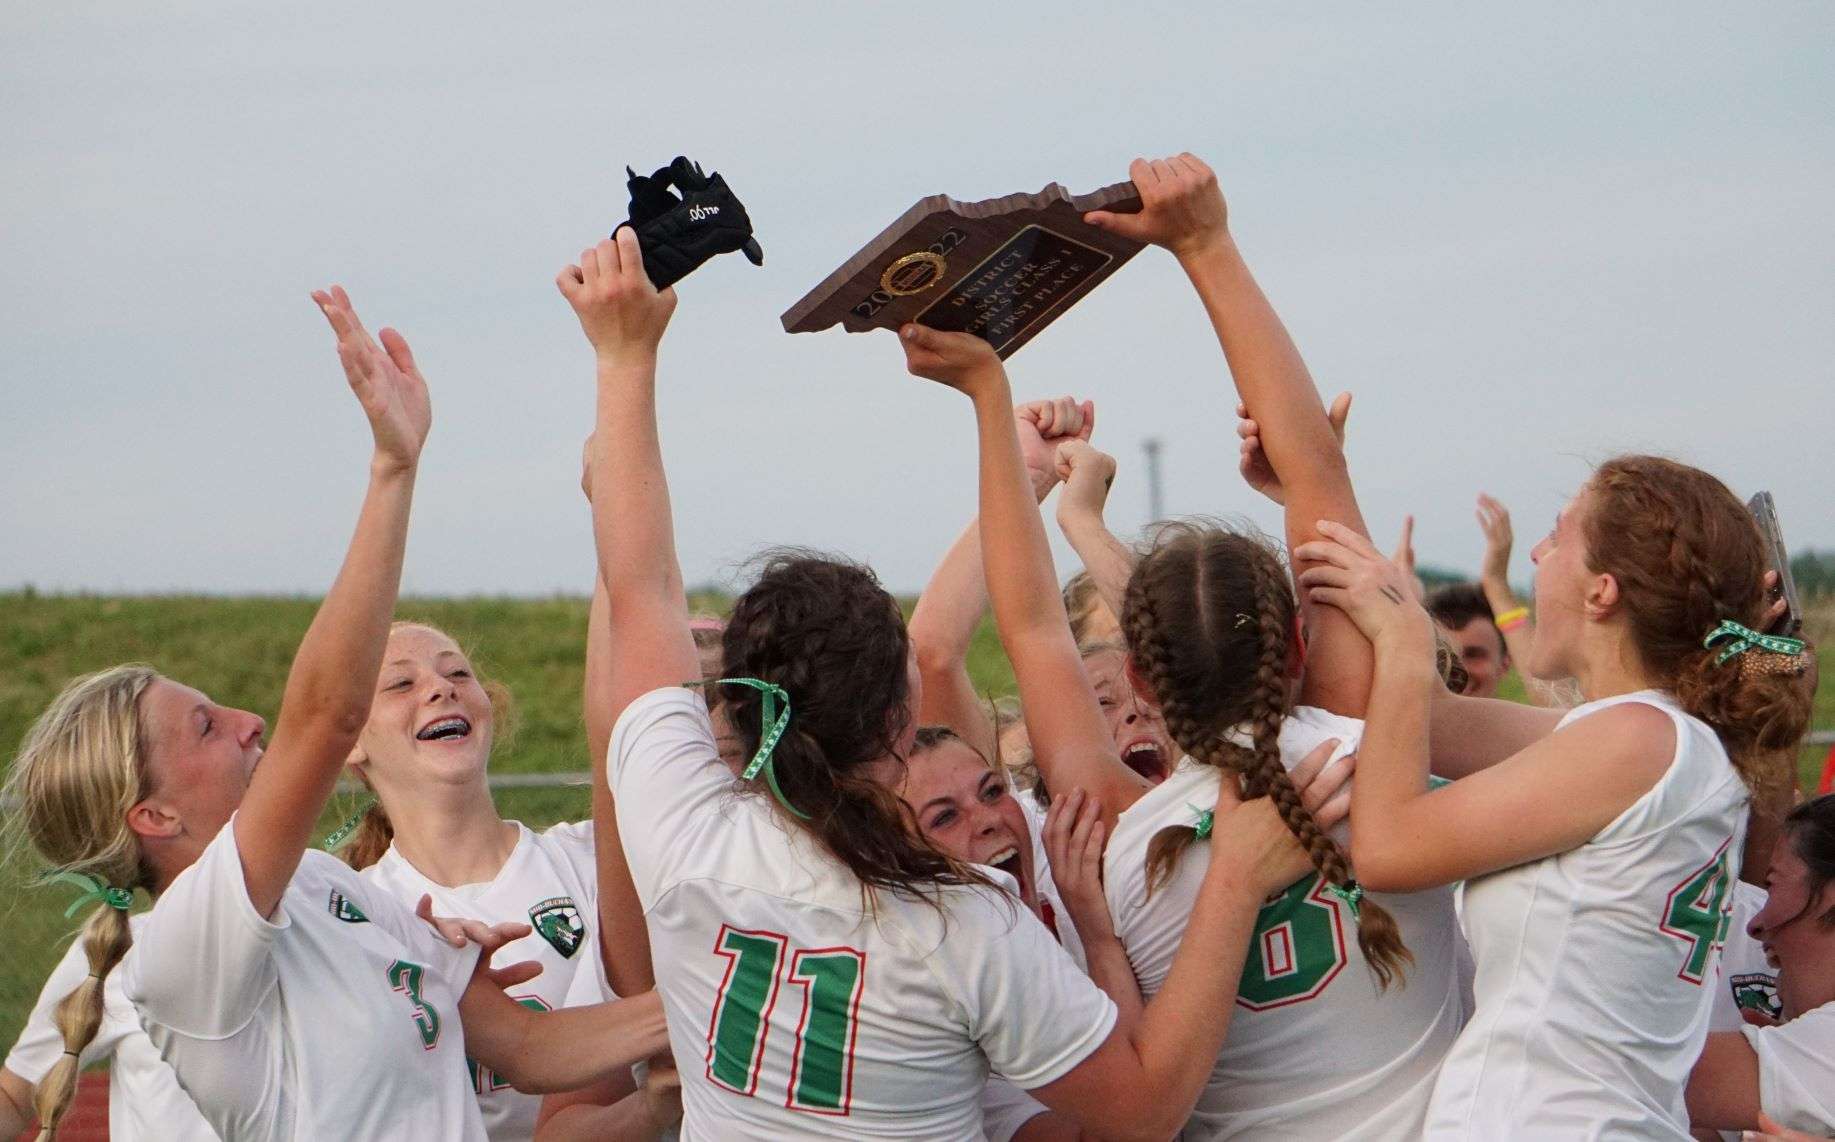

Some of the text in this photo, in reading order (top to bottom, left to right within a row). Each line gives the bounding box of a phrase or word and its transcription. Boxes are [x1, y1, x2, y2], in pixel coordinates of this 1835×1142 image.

[951, 249, 1024, 307] DISTRICT
[975, 262, 1039, 311] SOCCER
[991, 263, 1084, 336] FIRST PLACE
[1012, 257, 1062, 296] CLASS
[386, 958, 441, 1051] 3
[705, 922, 866, 1116] 11
